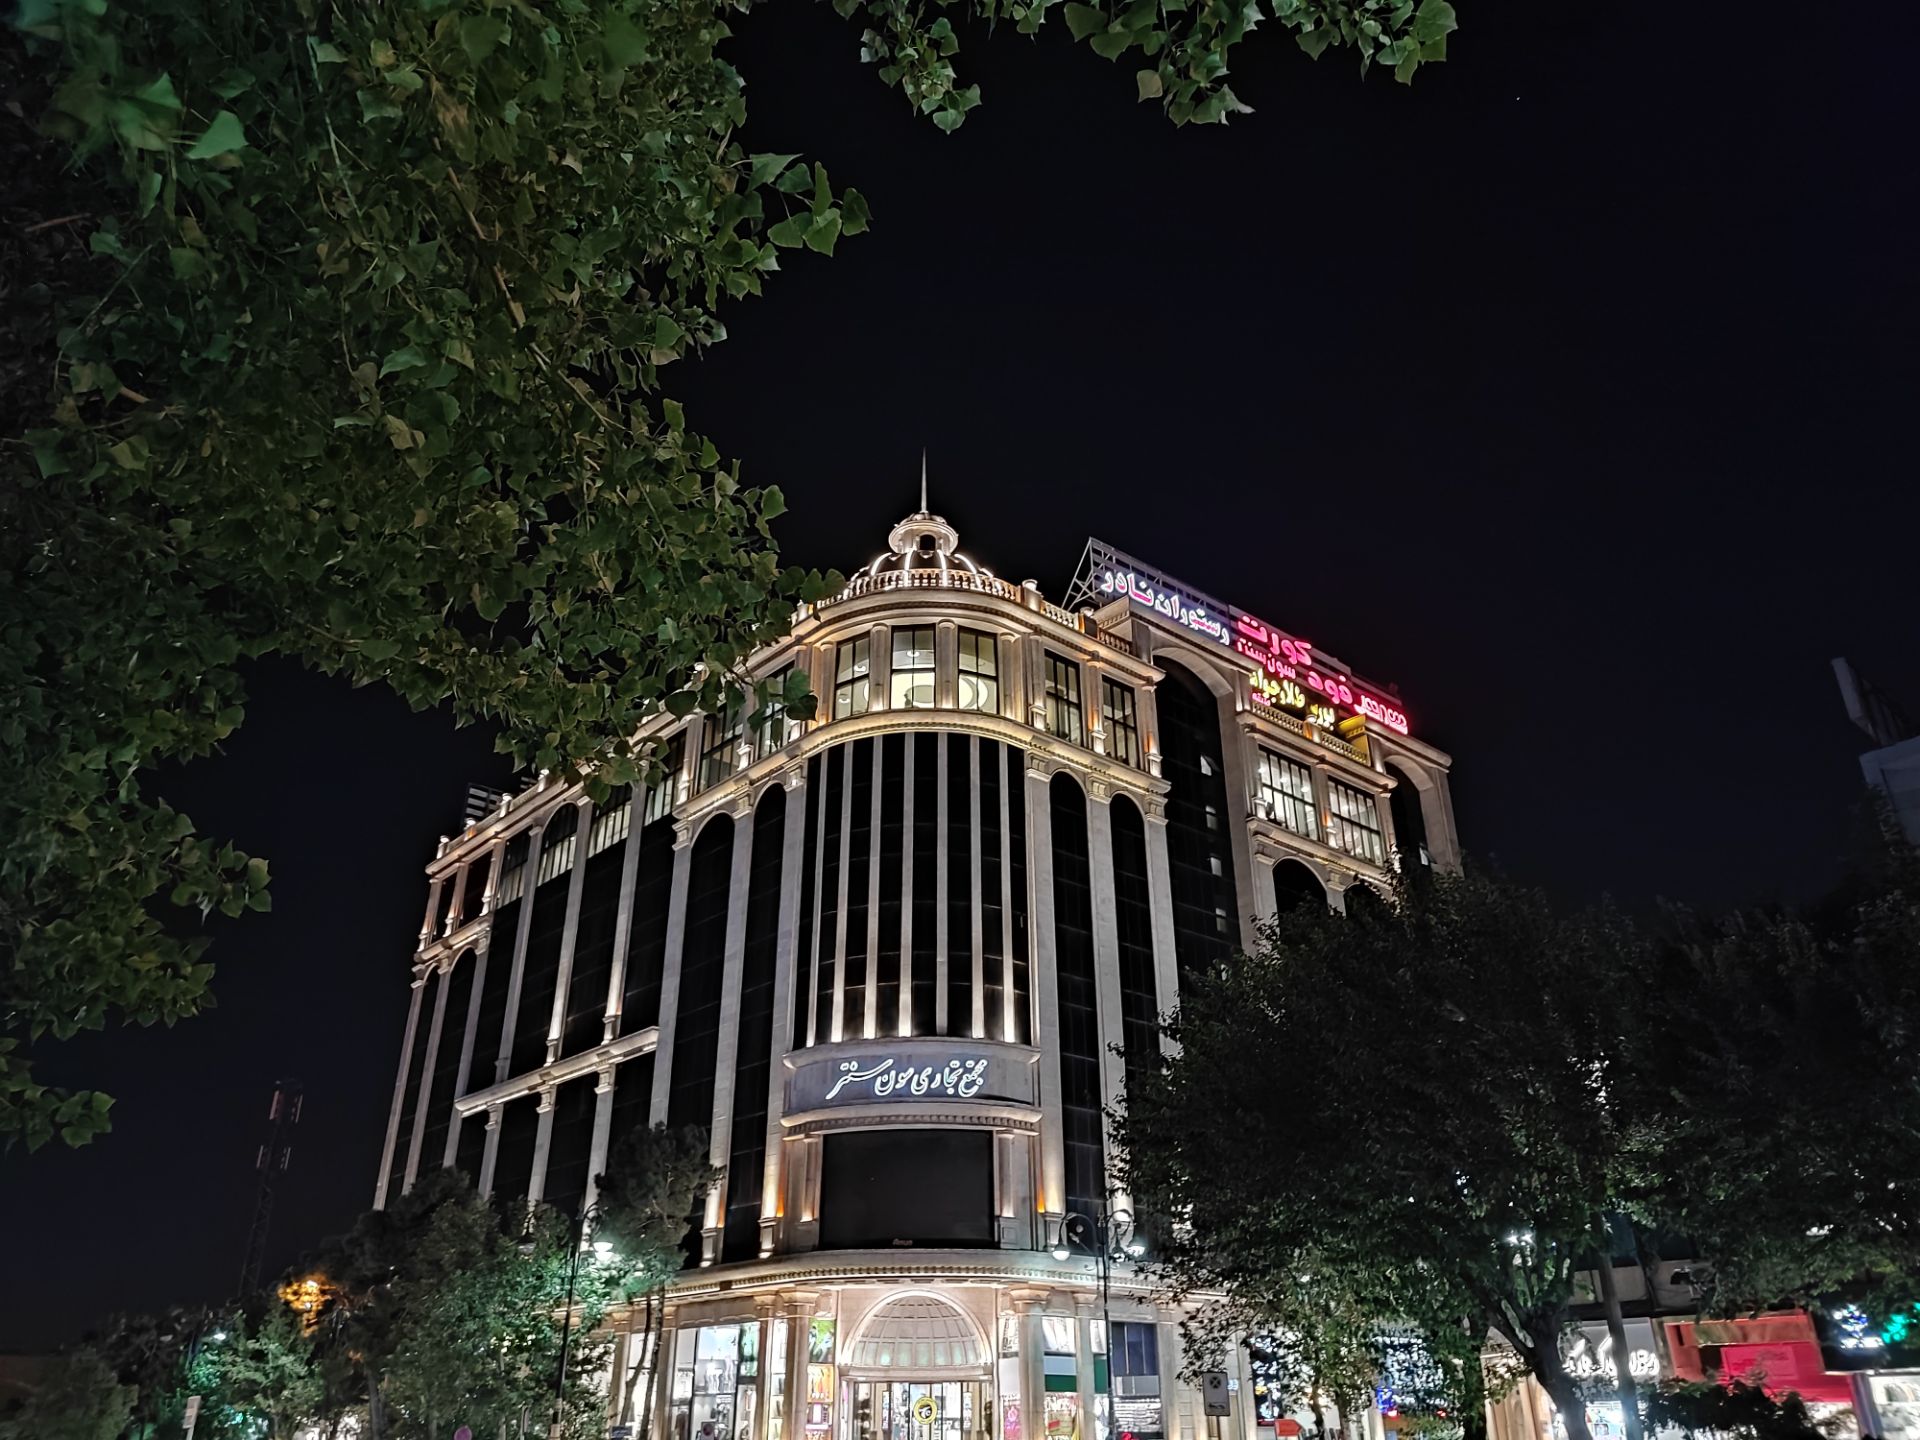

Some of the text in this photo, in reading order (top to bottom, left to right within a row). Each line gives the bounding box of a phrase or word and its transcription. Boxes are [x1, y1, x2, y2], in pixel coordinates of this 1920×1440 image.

[1100, 571, 1230, 645] رستوران نادر
[1237, 615, 1312, 666] کورت
[1266, 653, 1297, 680] سون
[1308, 671, 1353, 705] فود
[825, 1058, 988, 1100] مجتمع تجاری سون سنتر
